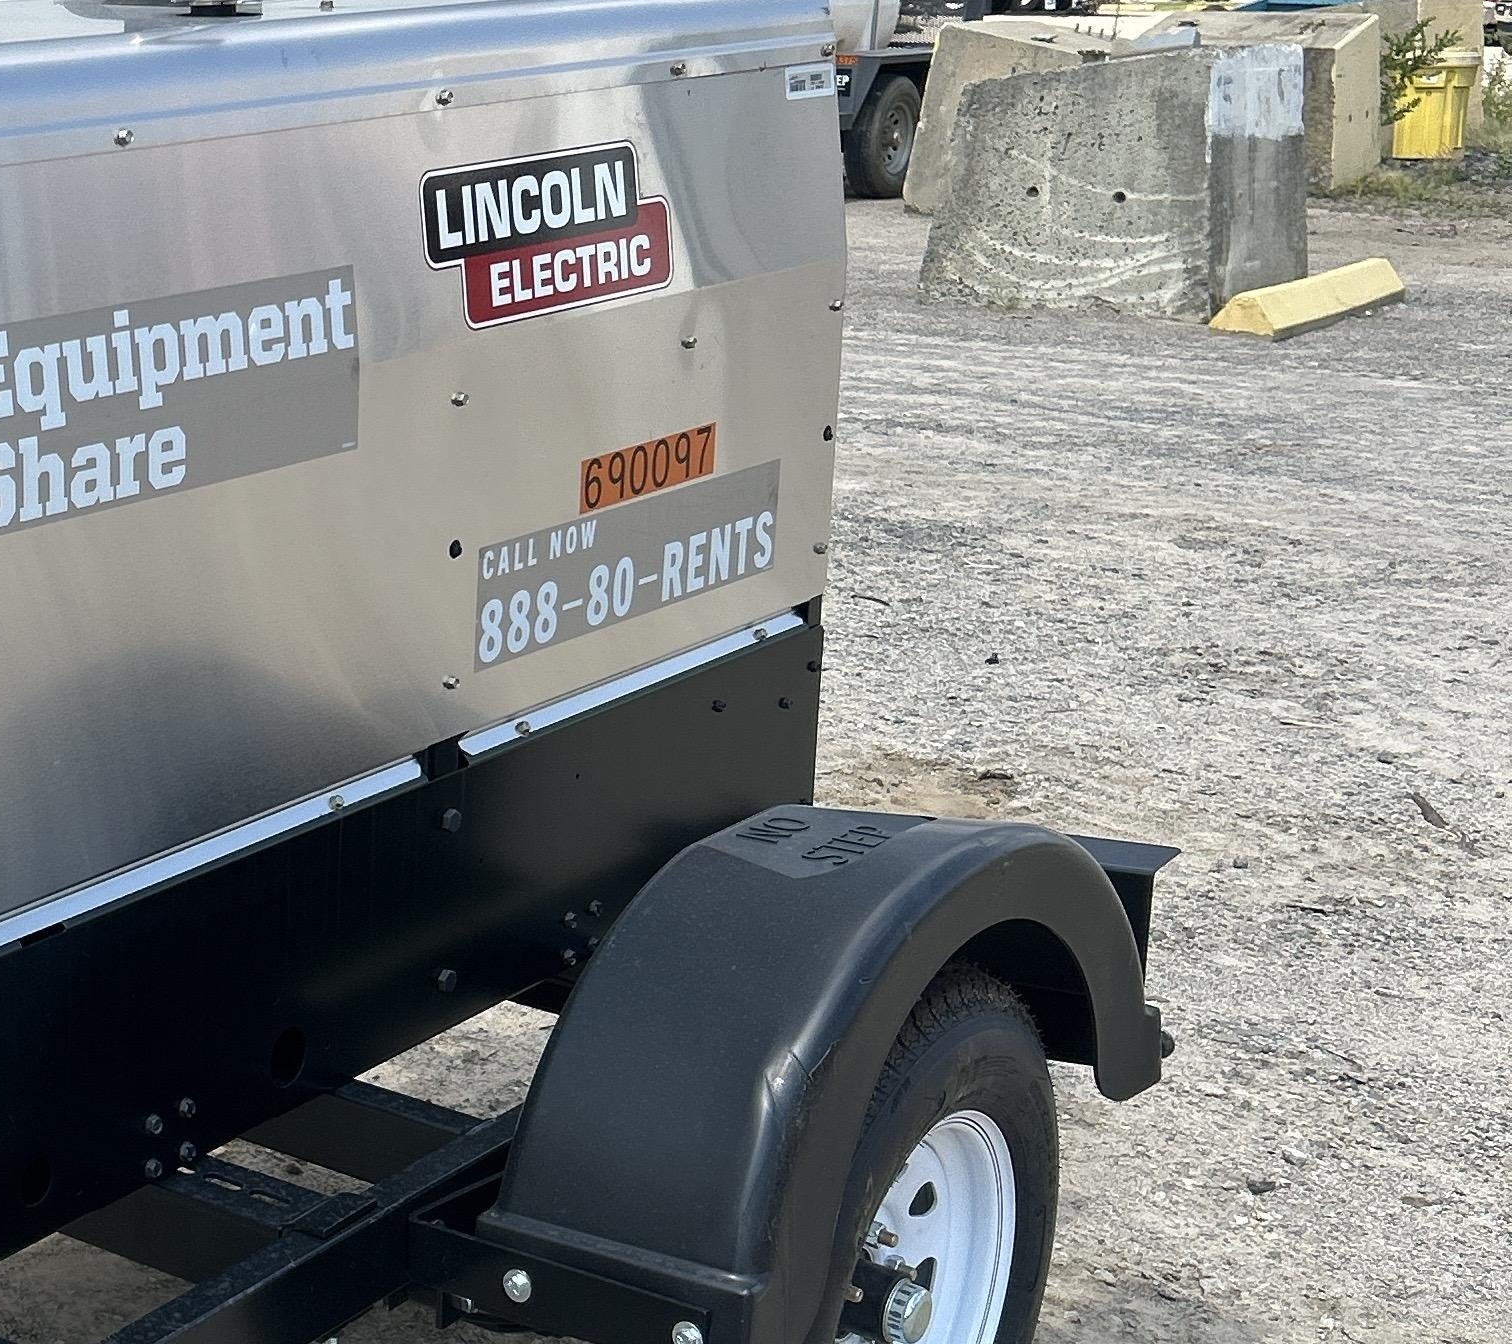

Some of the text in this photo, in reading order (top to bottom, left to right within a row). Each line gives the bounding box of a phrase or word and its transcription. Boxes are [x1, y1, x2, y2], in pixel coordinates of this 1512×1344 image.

[435, 160, 627, 250] LINCOLN
[490, 234, 651, 308] ELECTRIC
[585, 426, 713, 509] 690097
[478, 511, 775, 663] 888-80-RENTS
[482, 519, 598, 580] CALL NOW
[735, 817, 811, 844] NO
